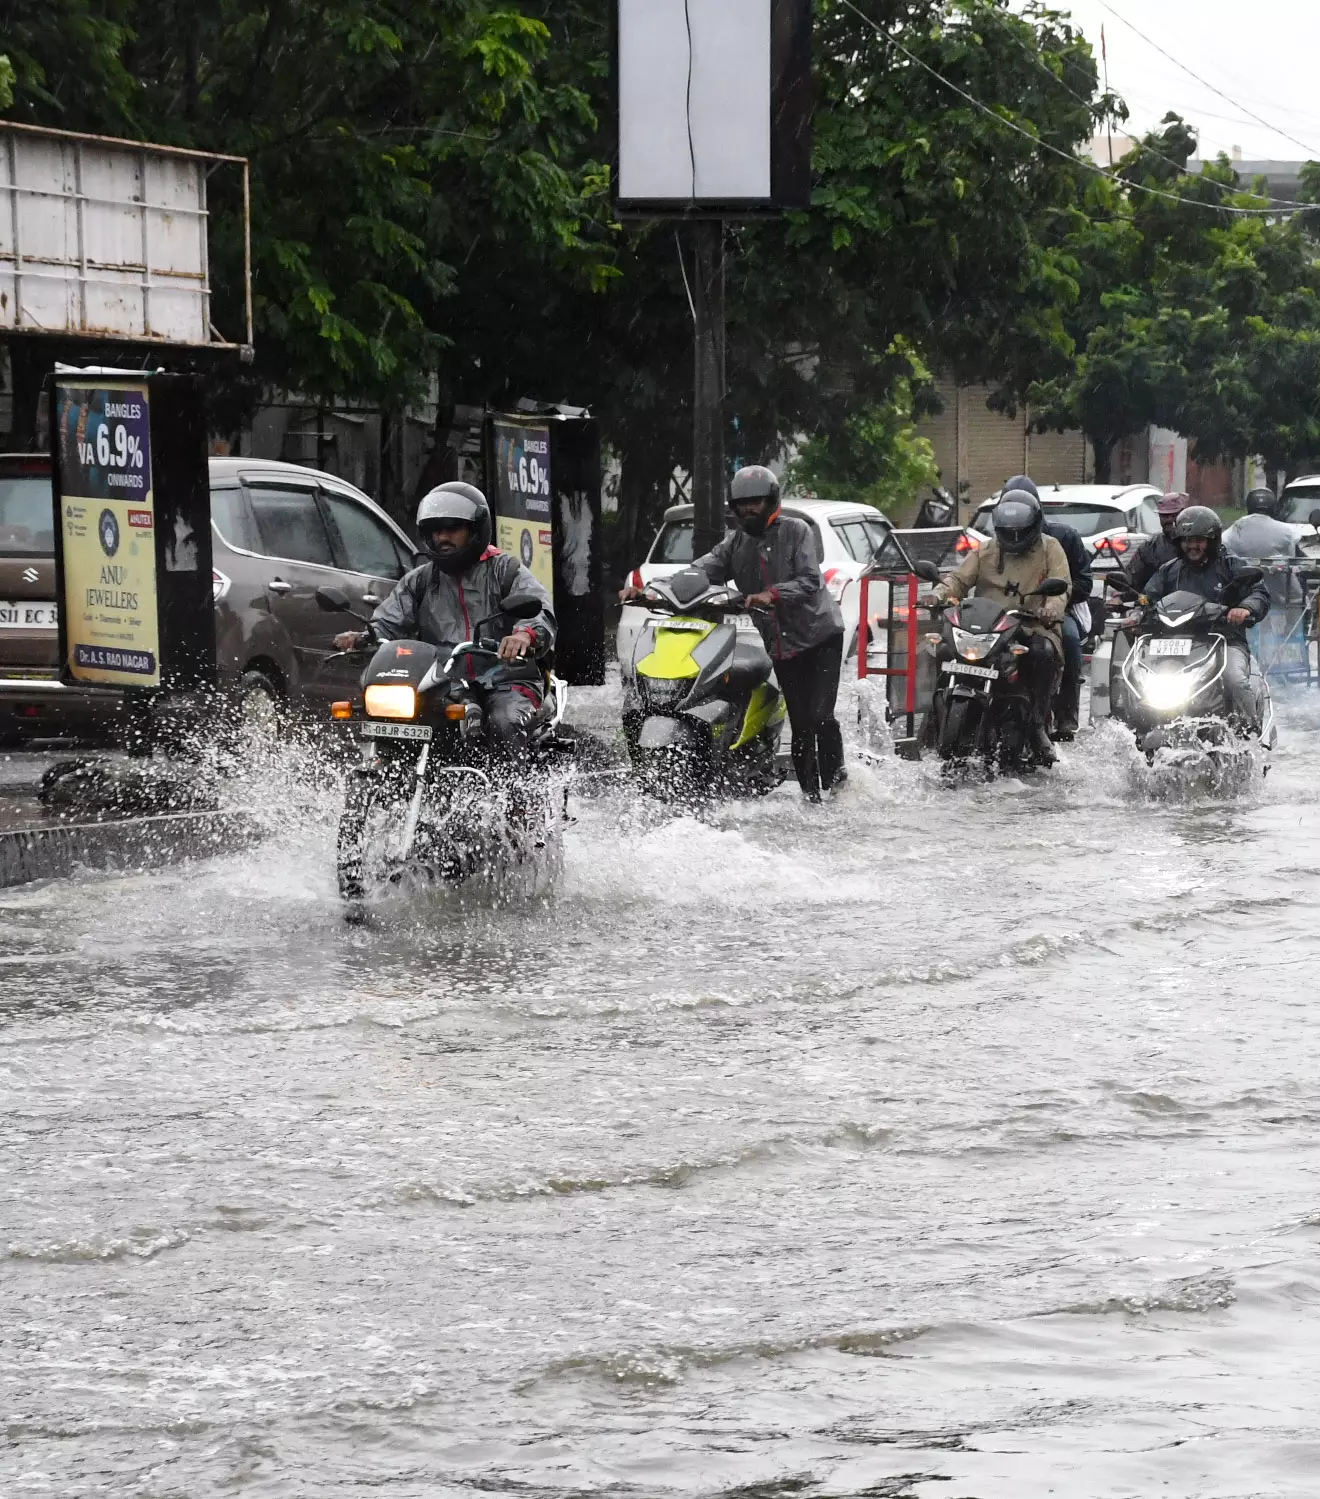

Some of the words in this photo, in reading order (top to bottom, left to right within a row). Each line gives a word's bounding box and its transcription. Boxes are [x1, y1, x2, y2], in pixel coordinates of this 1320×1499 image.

[105, 403, 141, 419] BANGLES
[78, 443, 95, 465] VA
[97, 423, 143, 468] 6.9%
[108, 473, 143, 488] ONWARDS
[519, 456, 550, 496] 6.9%
[99, 565, 123, 585] ANU
[86, 588, 138, 610] JEWELLERS
[25, 609, 44, 624] EC
[122, 653, 149, 669] NAGAR
